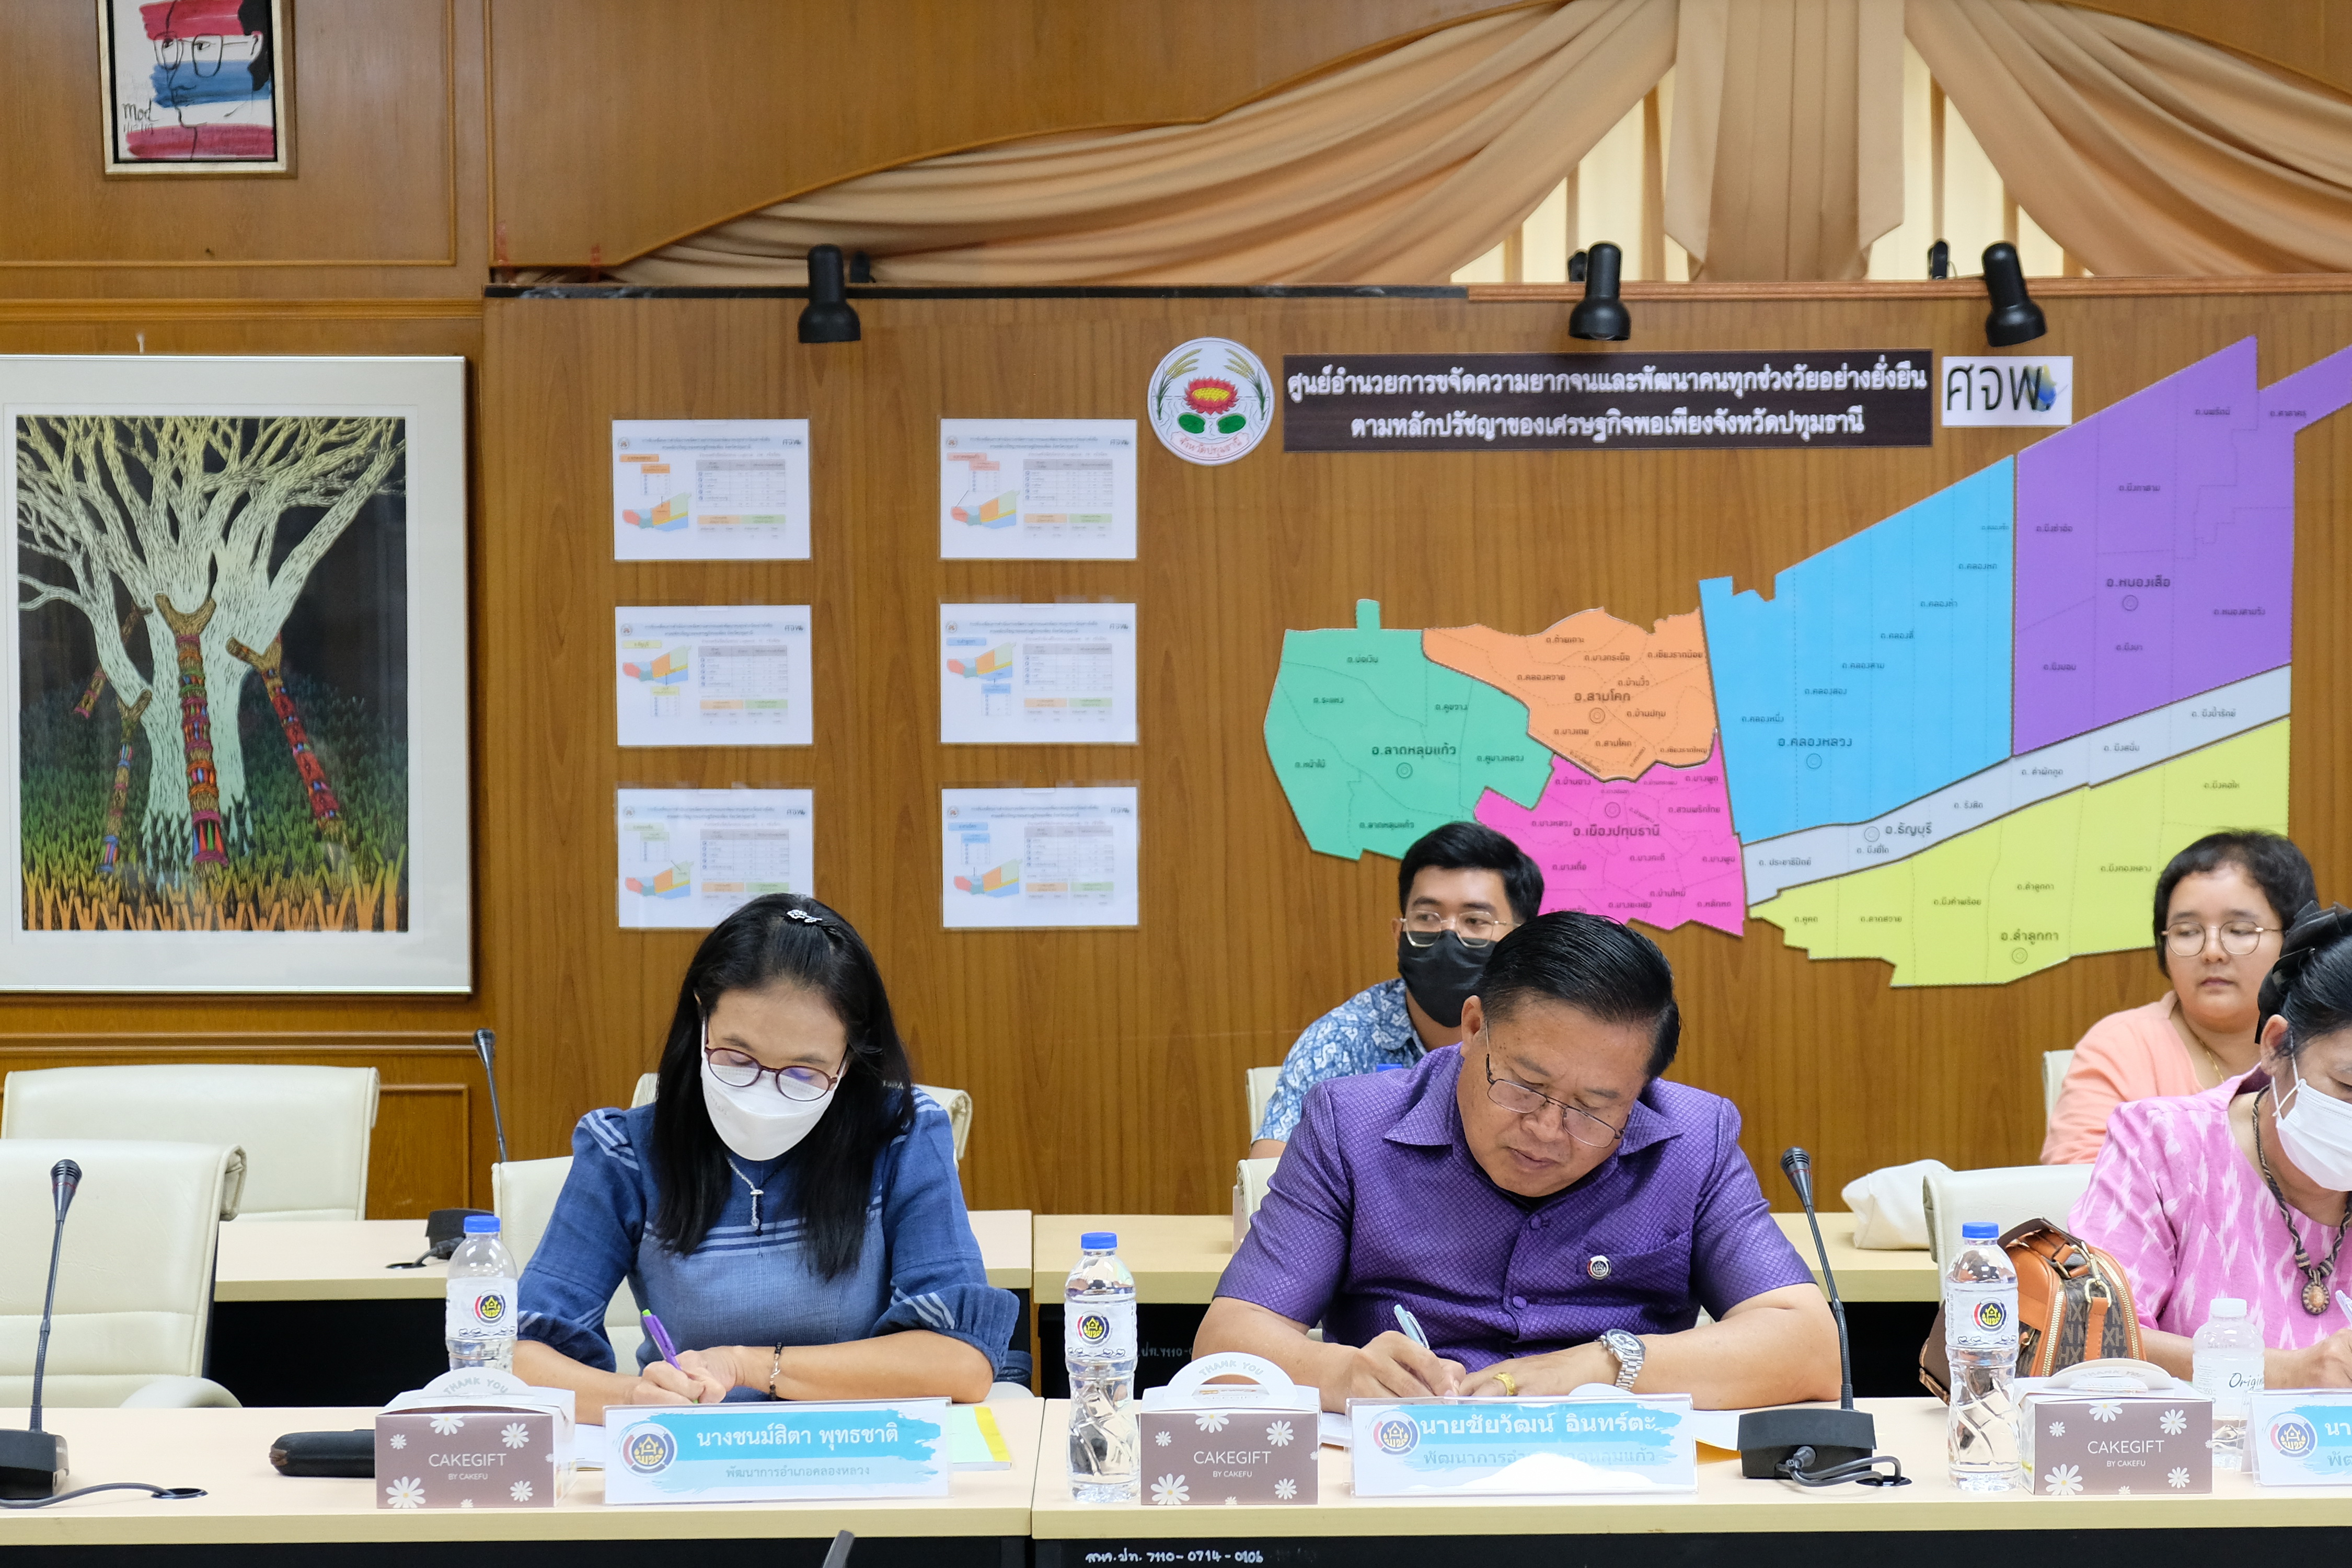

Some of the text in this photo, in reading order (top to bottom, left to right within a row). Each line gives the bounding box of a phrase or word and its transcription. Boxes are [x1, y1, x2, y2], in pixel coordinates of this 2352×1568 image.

[1287, 355, 1927, 402] ศูนย์อำนวยการขจัดความยากจนและพัฒนาคนทุกช่วงวัยอย่างยั่งยืน
[1351, 405, 1864, 443] ตามหลักปรัชญาของเศรษฐกิจพอเพียงจังหวัดปทุมธานี
[2106, 575, 2171, 588] อ.หนองเสือ
[1574, 689, 1630, 701] อ.สามโคก
[1778, 736, 1852, 747] อ.คลองหลวง
[1371, 742, 1456, 759] อ.ลาดหลุมแก้ว
[1573, 823, 1660, 839] อ.เมืองปทุมธานี
[1885, 822, 1932, 837] อ.ธัญบุรี
[2001, 929, 2059, 945] อ.ลำลูกกา
[1199, 1359, 1264, 1376] THANK YOU
[444, 1377, 509, 1395] THANK YOU
[1420, 1411, 1656, 1435] นายชัยวัฒน์ อินทร์ตะ
[697, 1422, 898, 1451] นางชนม์สิตา พุทธชาติ
[2088, 1440, 2165, 1454] CAKEGIFT
[429, 1454, 506, 1467] CAKEGIFT
[1194, 1451, 1271, 1465] CAKEGIFT
[726, 1465, 870, 1478] พัฒนาการอำเภอคลองหลวง
